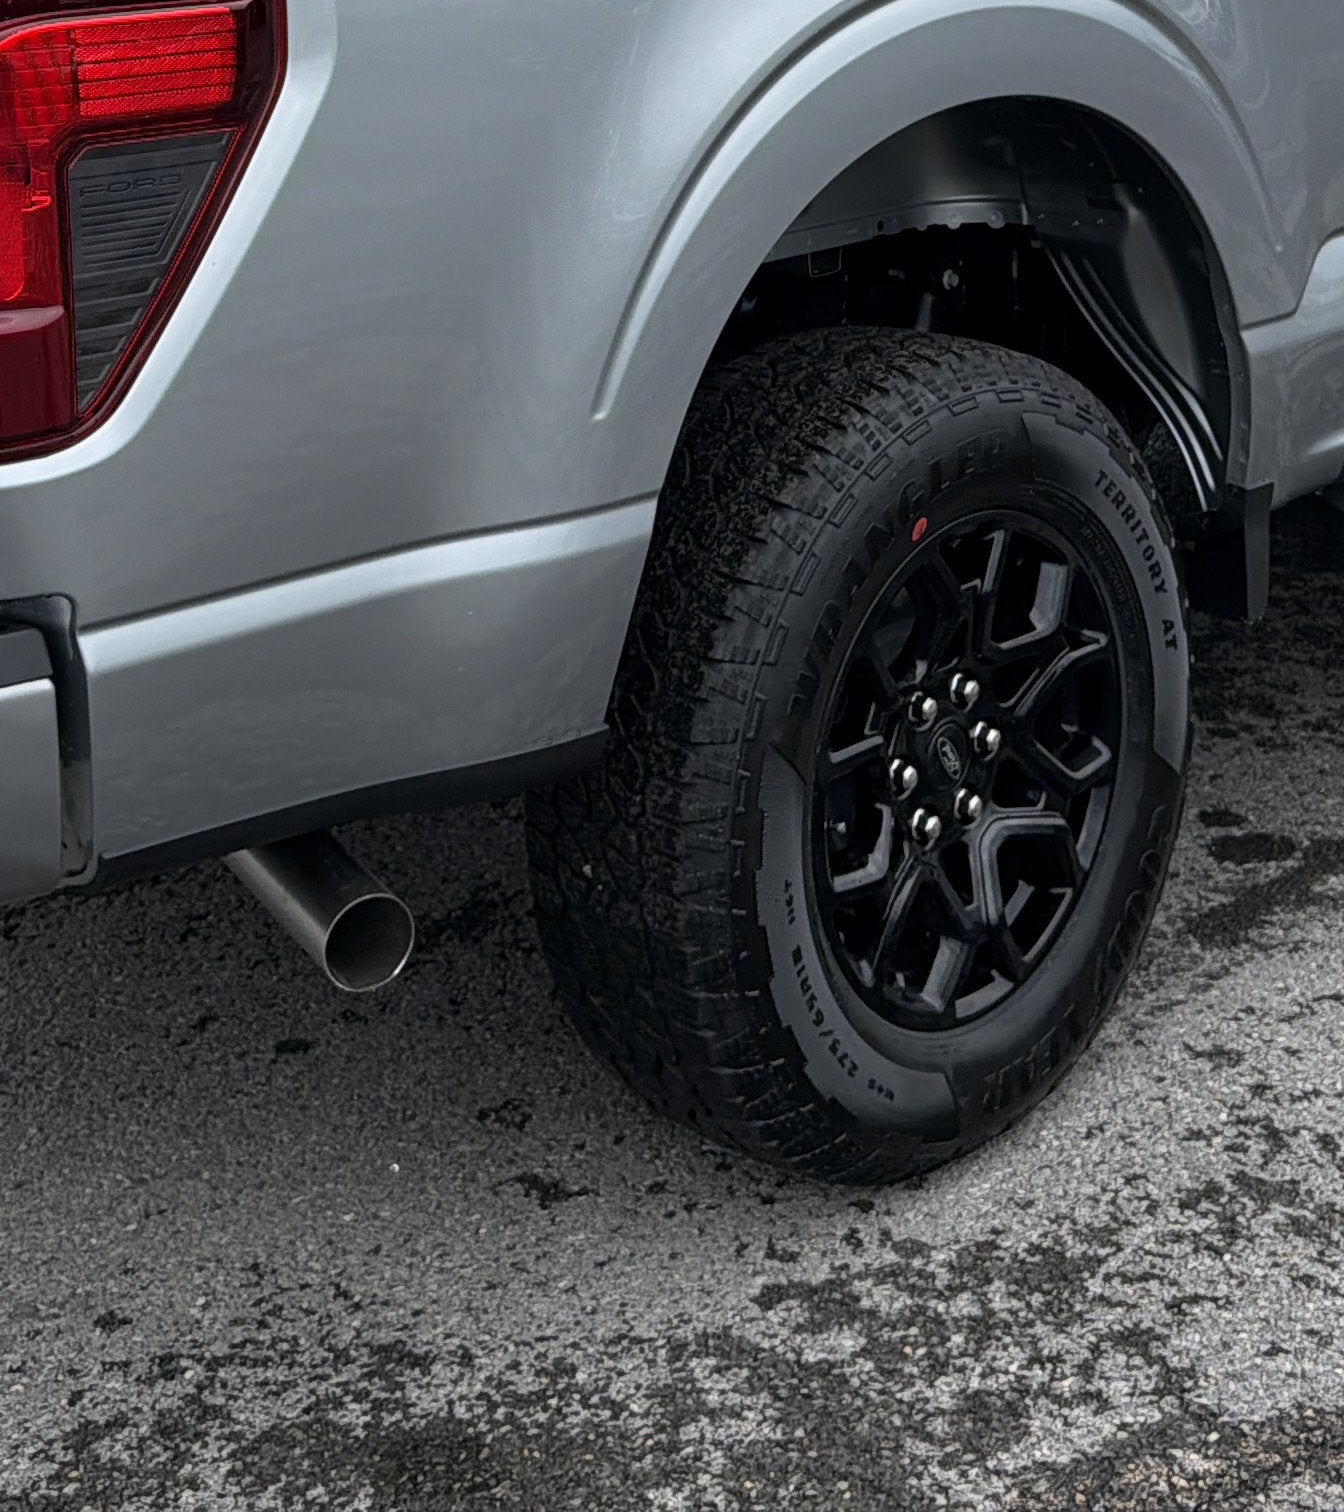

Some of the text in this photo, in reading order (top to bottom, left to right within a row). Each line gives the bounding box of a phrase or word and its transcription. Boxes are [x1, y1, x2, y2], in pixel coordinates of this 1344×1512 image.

[79, 173, 182, 197] FORD
[1095, 469, 1168, 594] TERRITORY
[1161, 619, 1178, 651] AT
[791, 944, 859, 1078] 275/65R18
